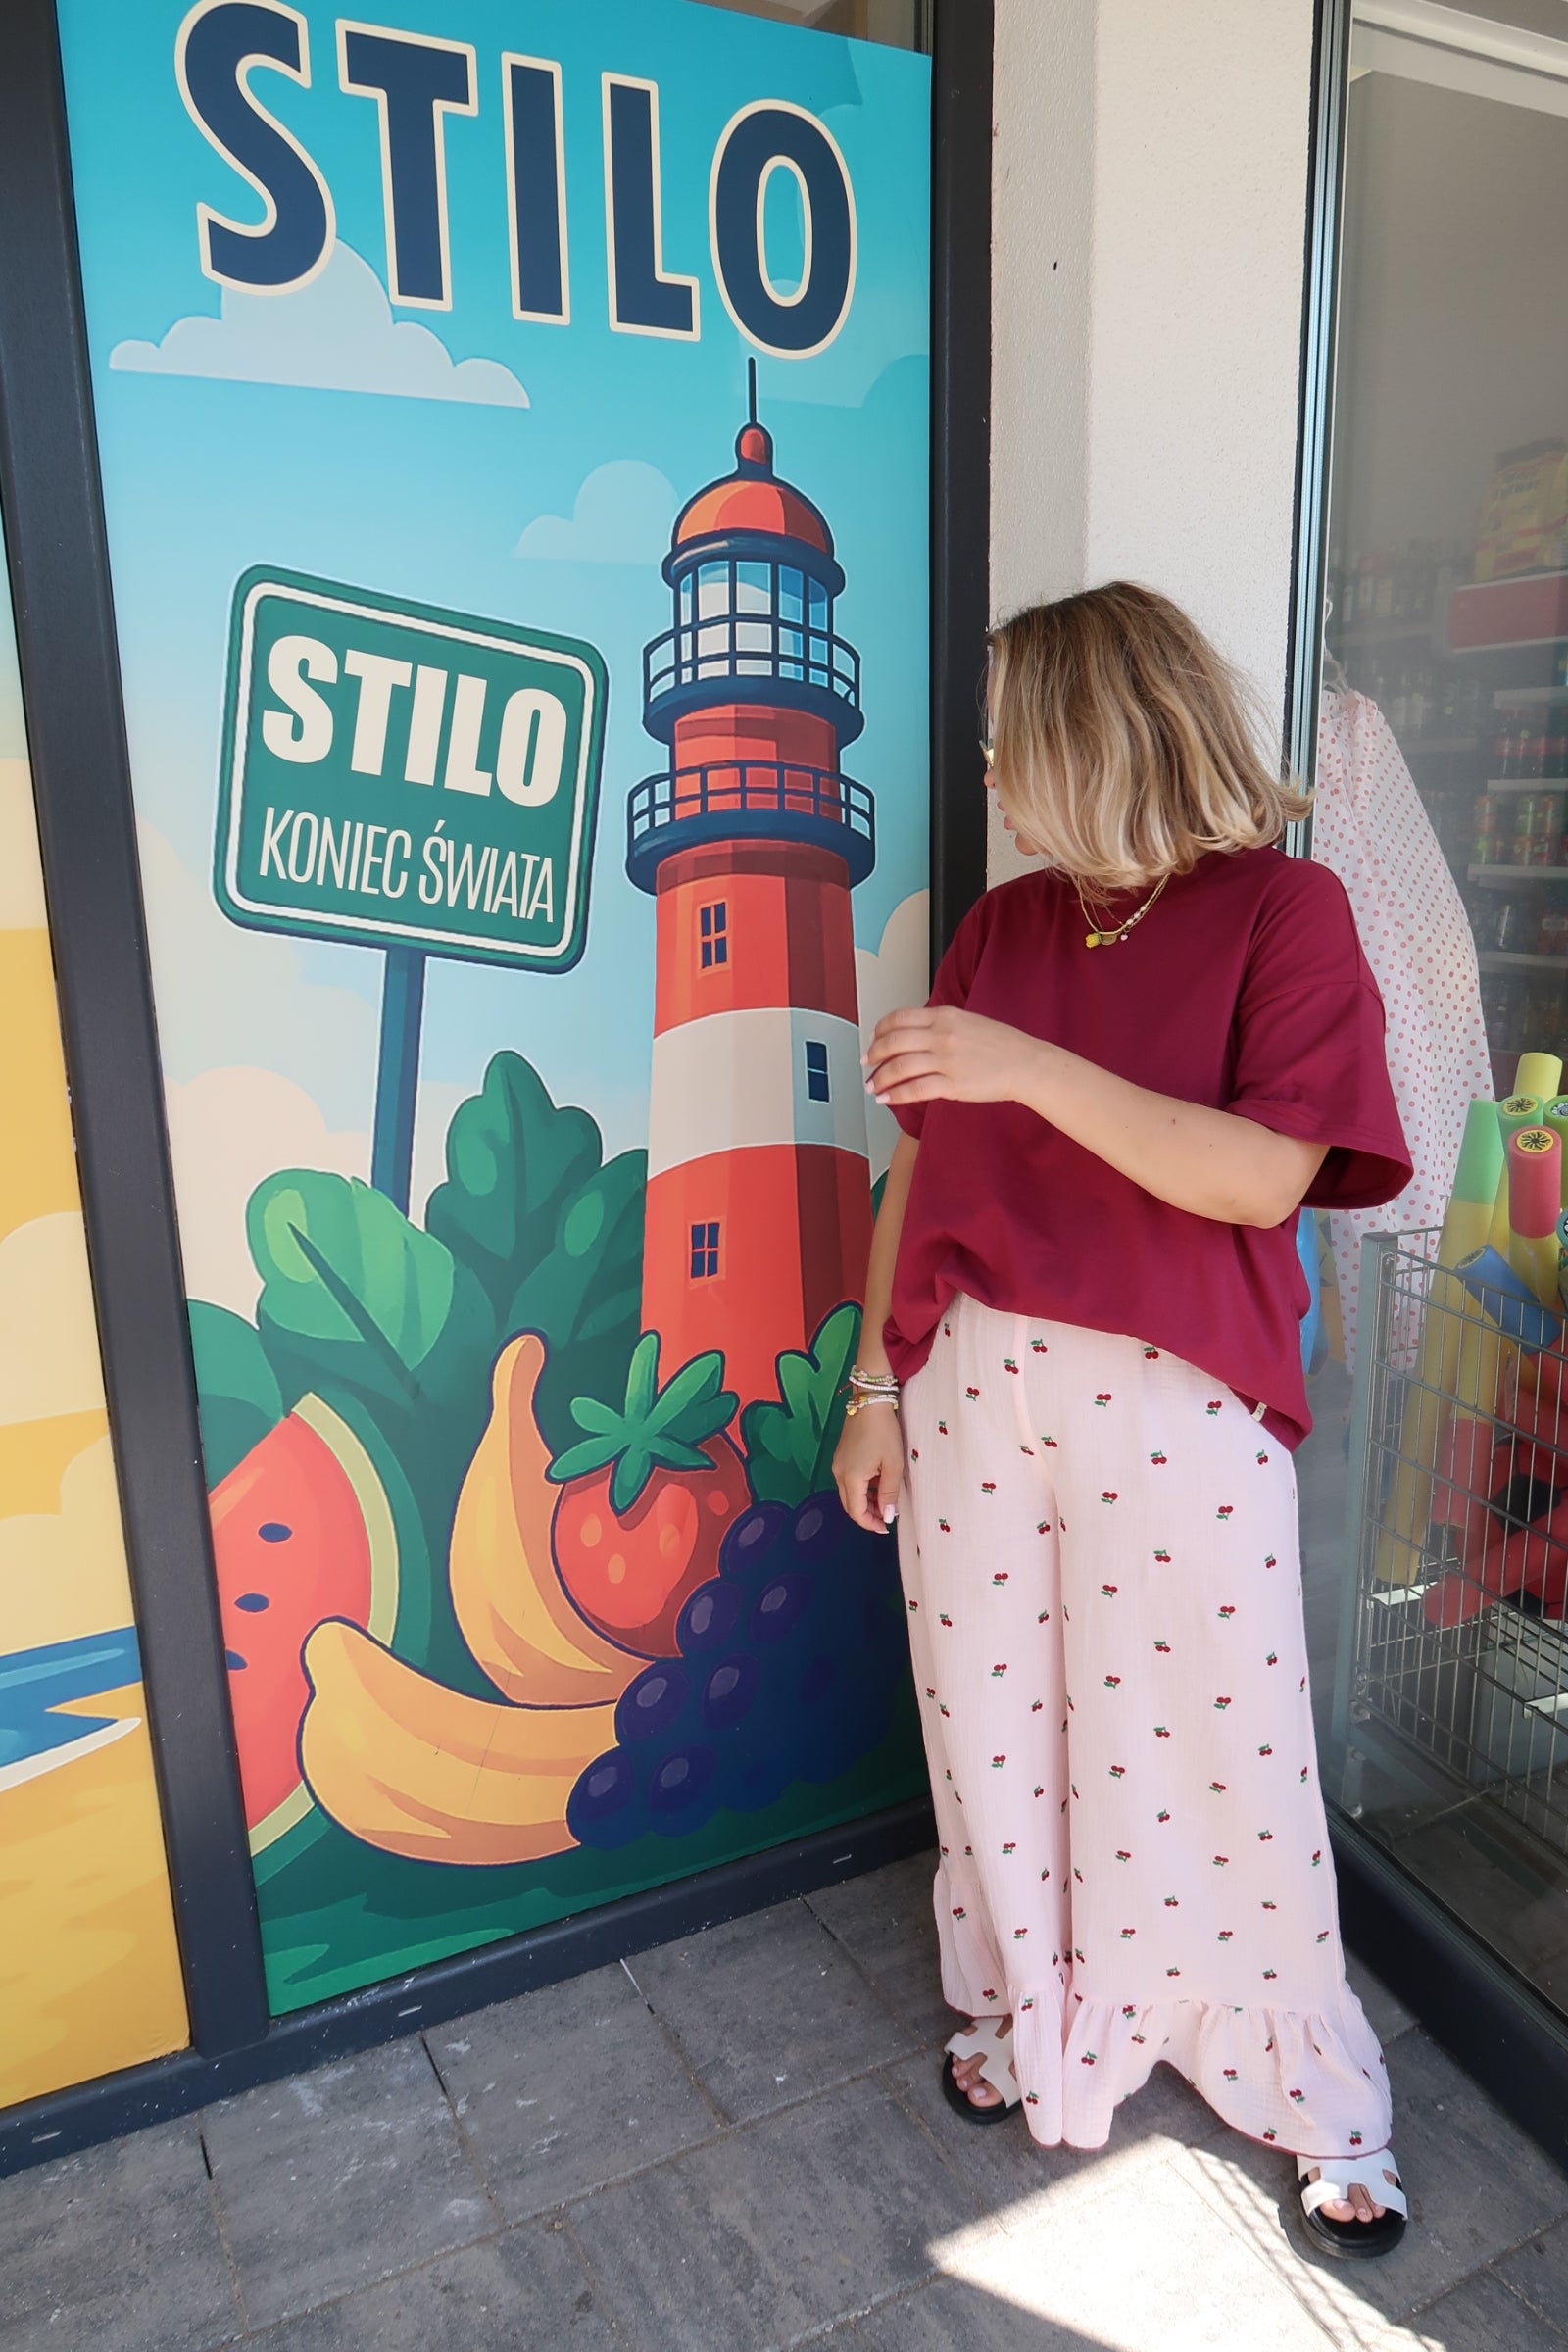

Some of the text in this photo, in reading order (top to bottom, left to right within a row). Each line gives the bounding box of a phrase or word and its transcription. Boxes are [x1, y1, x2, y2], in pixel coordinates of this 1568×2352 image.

[175, 0, 858, 360] STILO
[262, 635, 567, 807] STILO
[259, 806, 553, 923] KONIEC ŚWIATA
